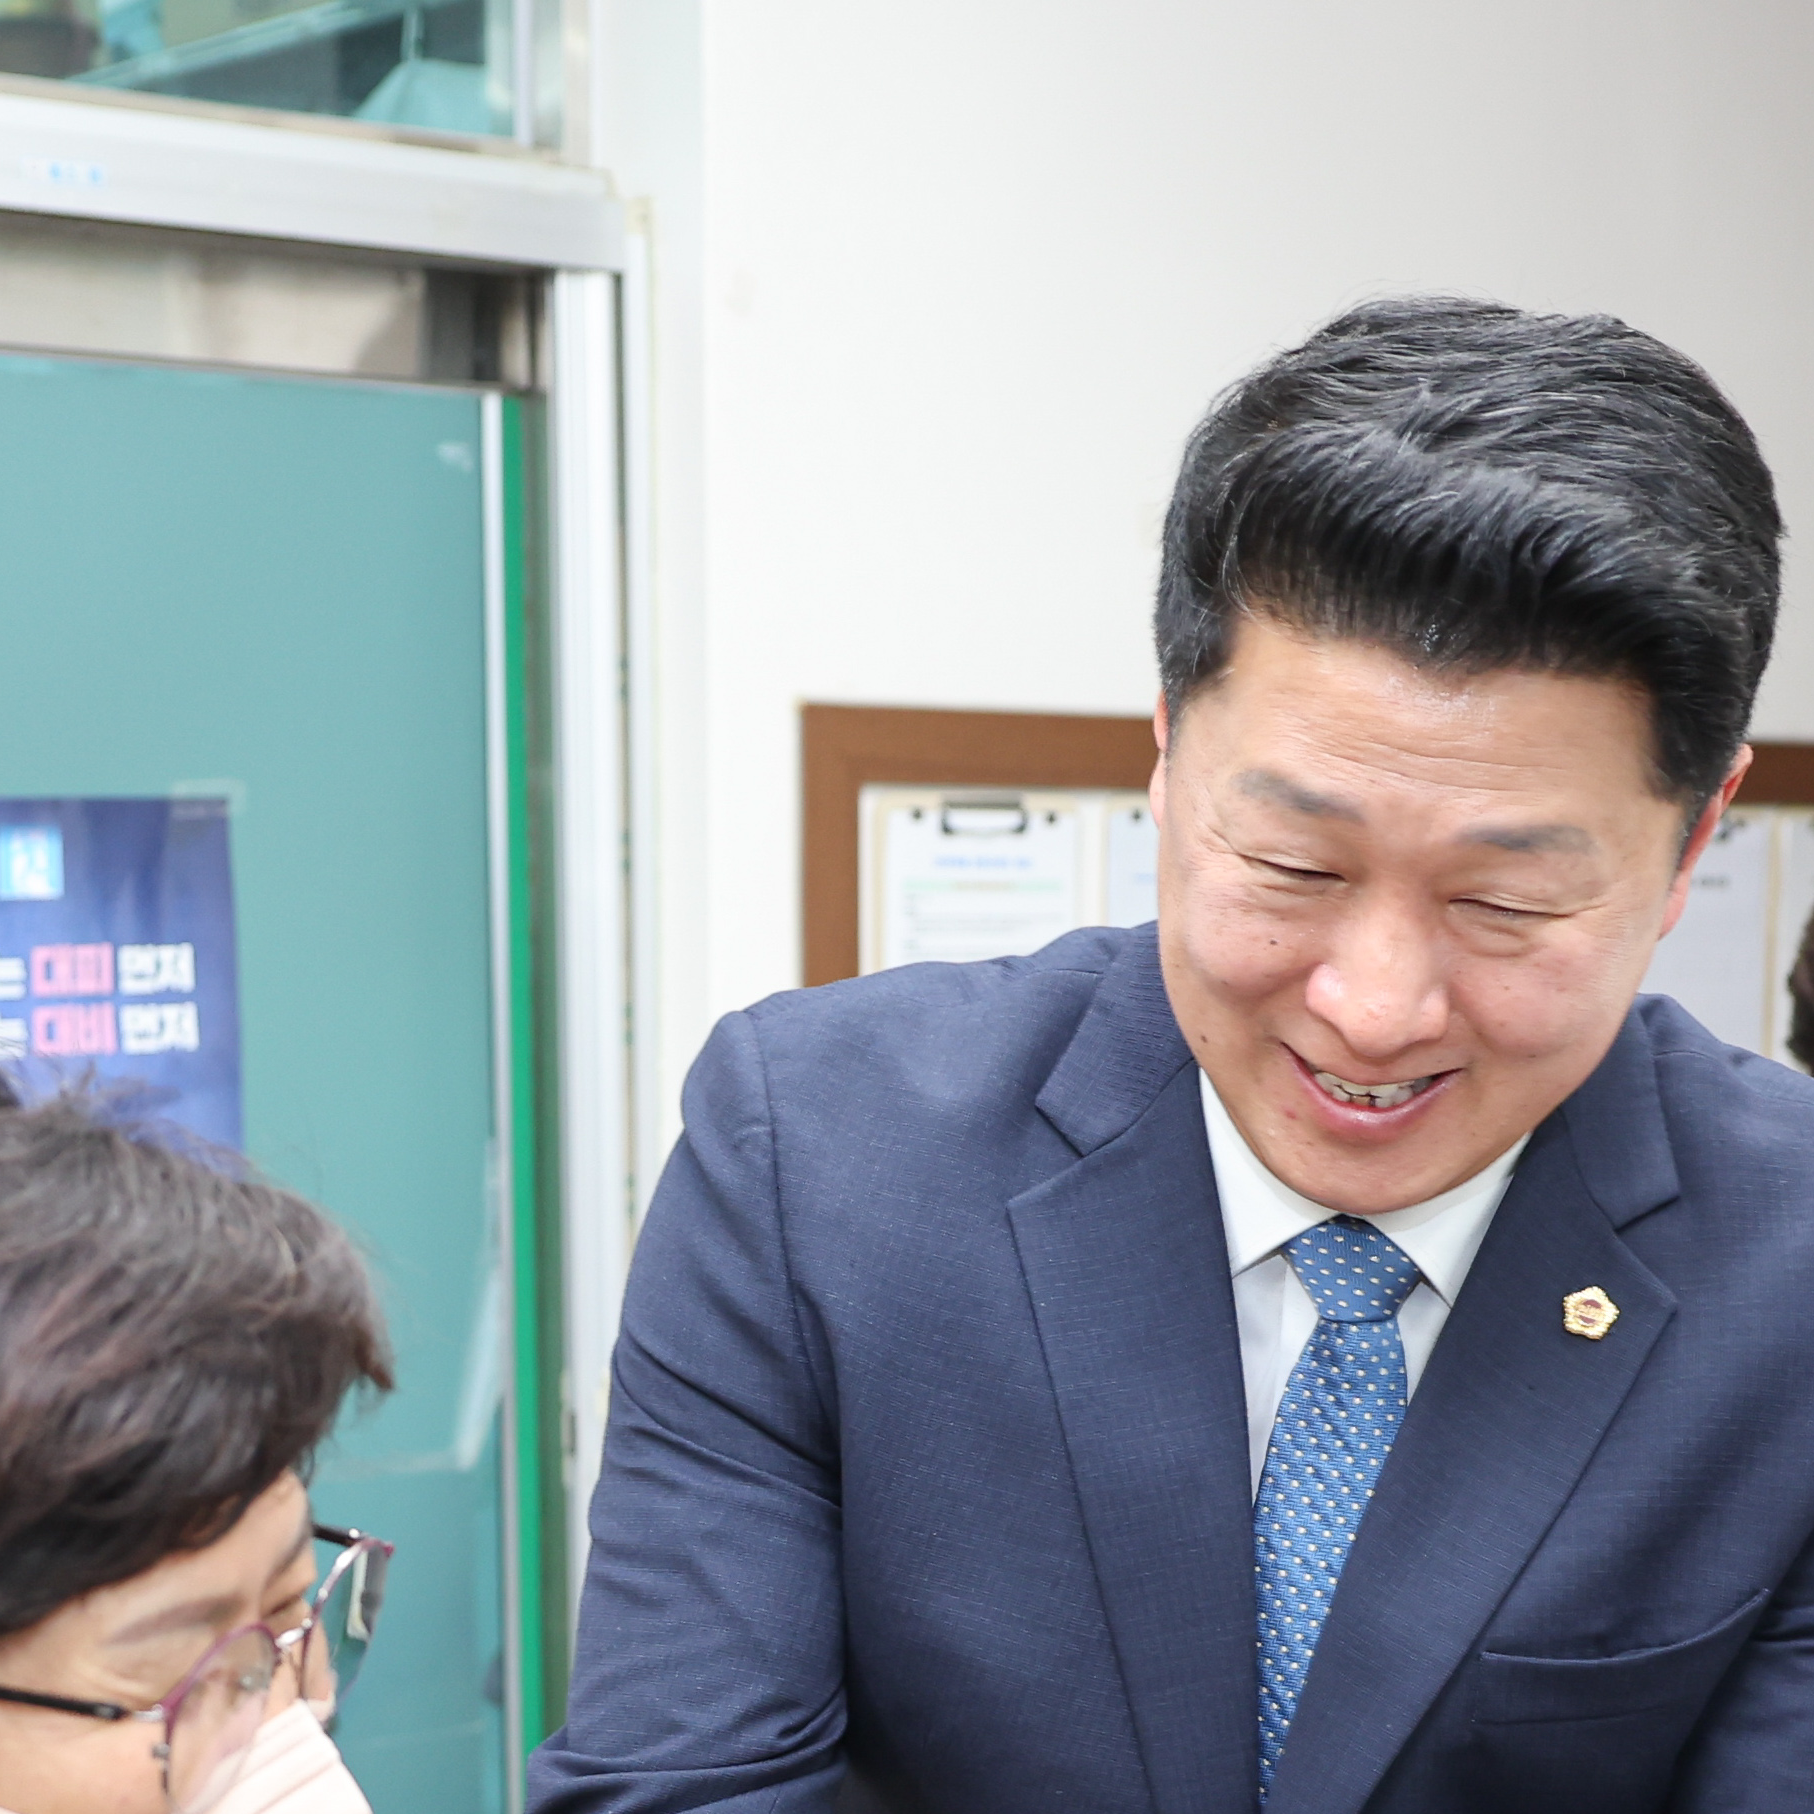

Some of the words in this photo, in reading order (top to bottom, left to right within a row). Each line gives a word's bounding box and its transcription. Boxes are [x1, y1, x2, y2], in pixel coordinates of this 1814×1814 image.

[30, 942, 115, 997] 대피
[118, 941, 197, 995] 먼저
[33, 1002, 118, 1056] 대비
[119, 1001, 200, 1055] 먼저
